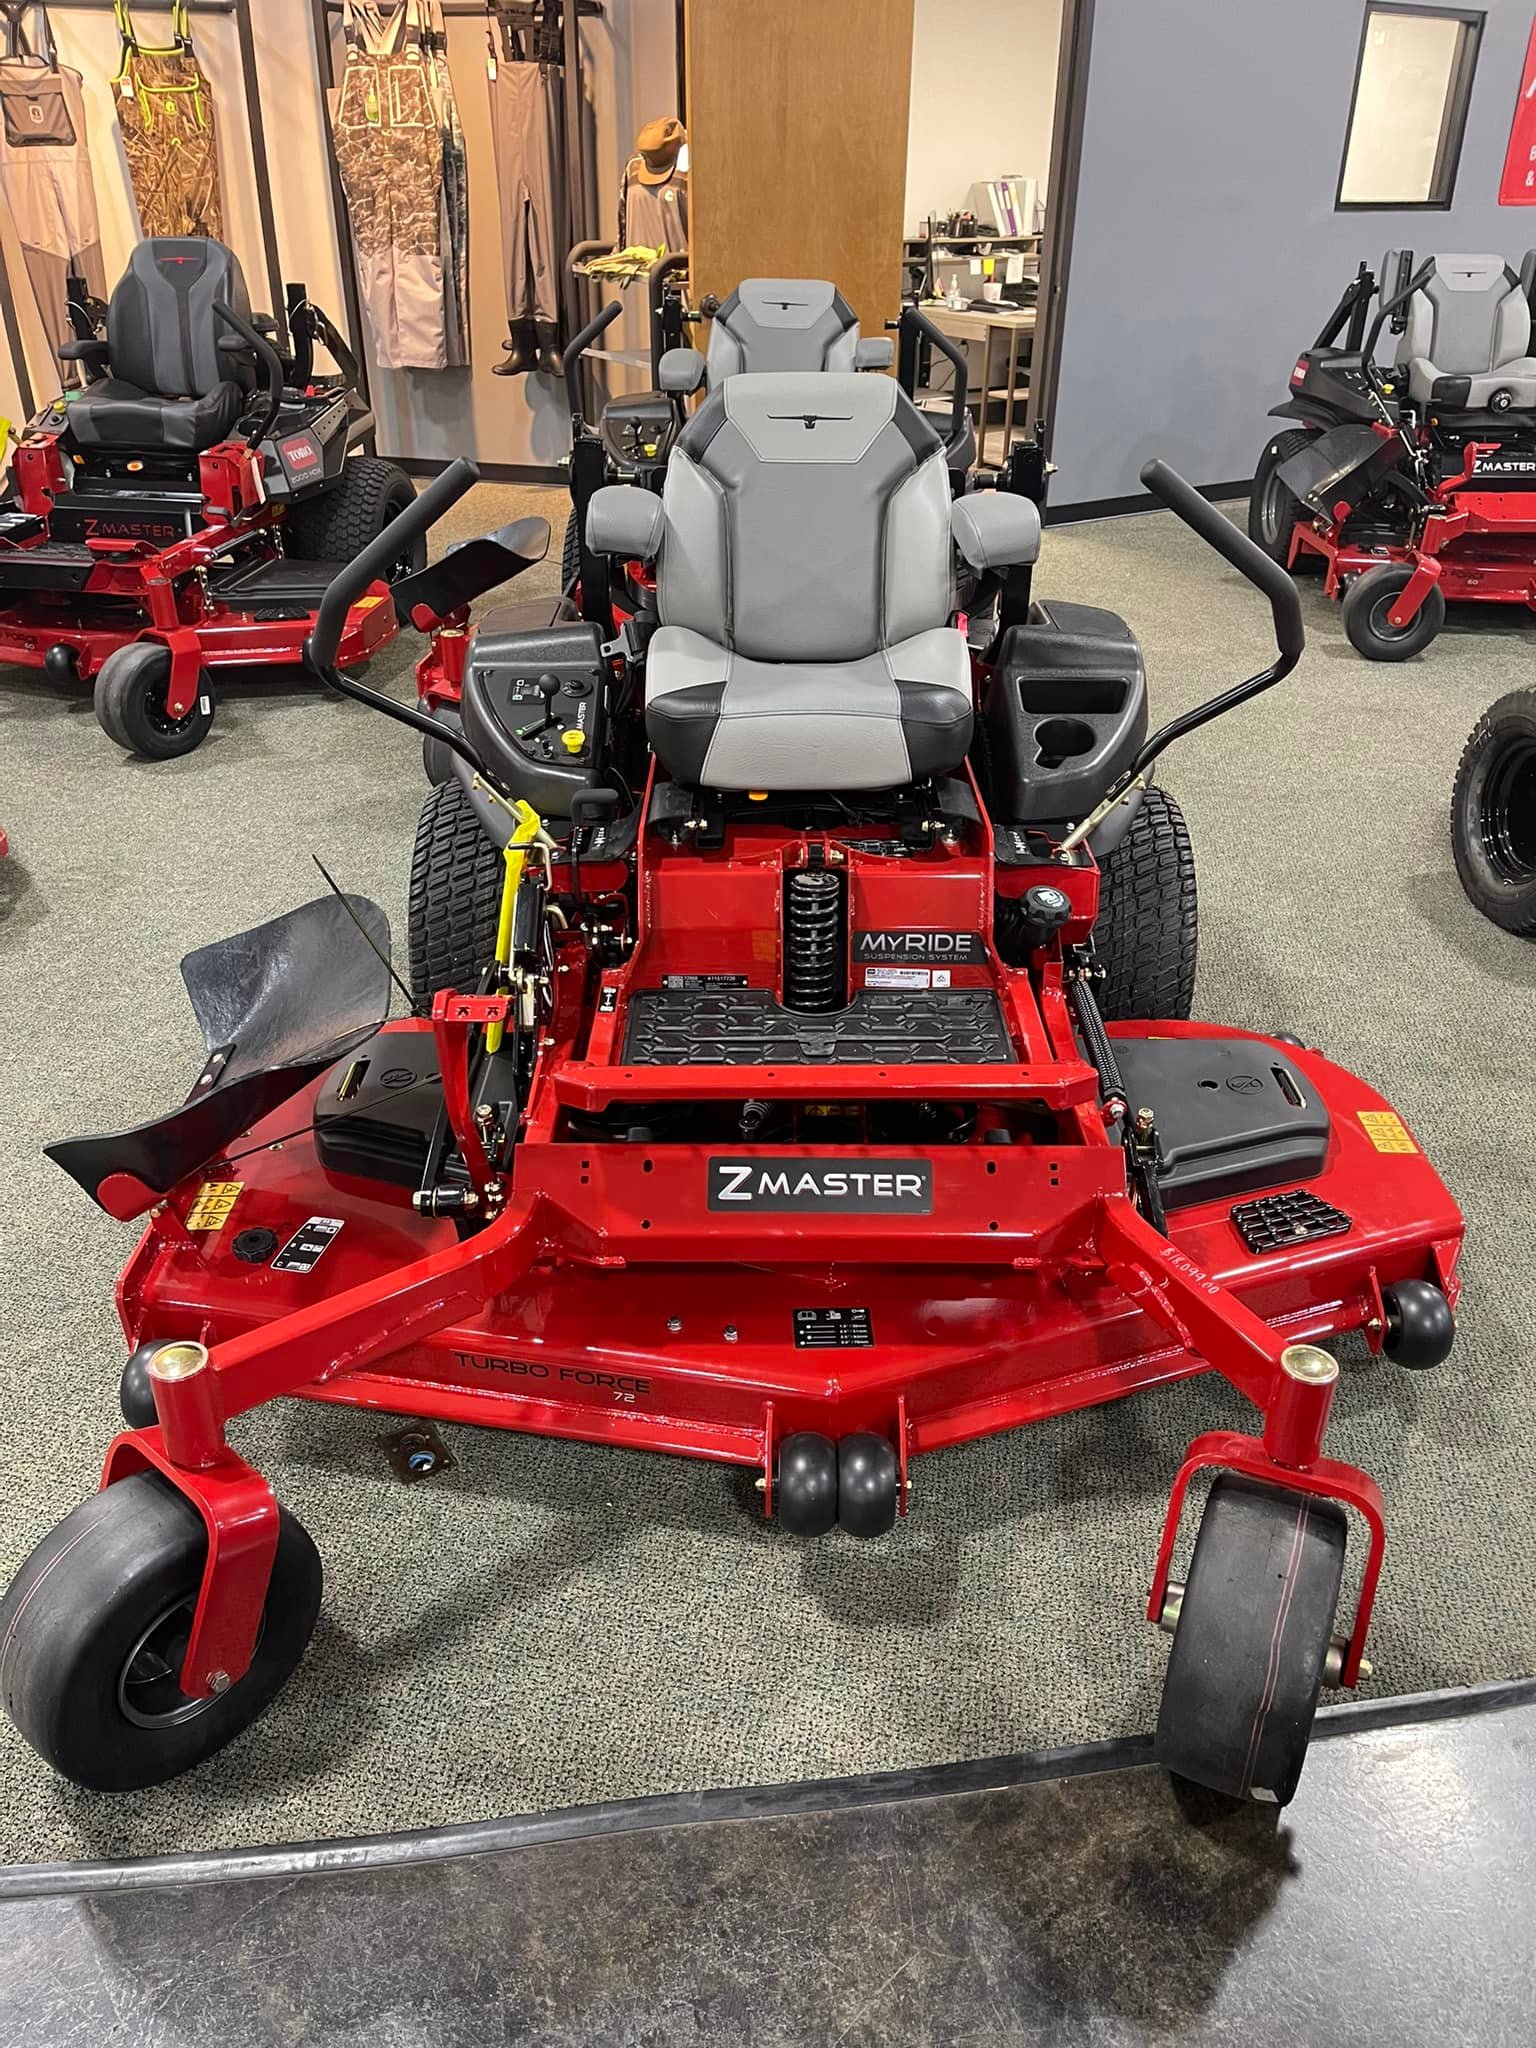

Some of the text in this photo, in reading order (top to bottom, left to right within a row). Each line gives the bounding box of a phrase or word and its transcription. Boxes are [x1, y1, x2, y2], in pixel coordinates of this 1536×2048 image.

[1525, 170, 1535, 187] &
[287, 445, 313, 462] TORO
[1473, 460, 1536, 473] Z MASTER
[83, 519, 175, 537] Z MASTER
[863, 953, 968, 961] SUSPENSION SYSTEM
[718, 1166, 922, 1201] Z MASTER
[455, 1353, 650, 1393] TURBO FORCE
[613, 1391, 636, 1403] 72
